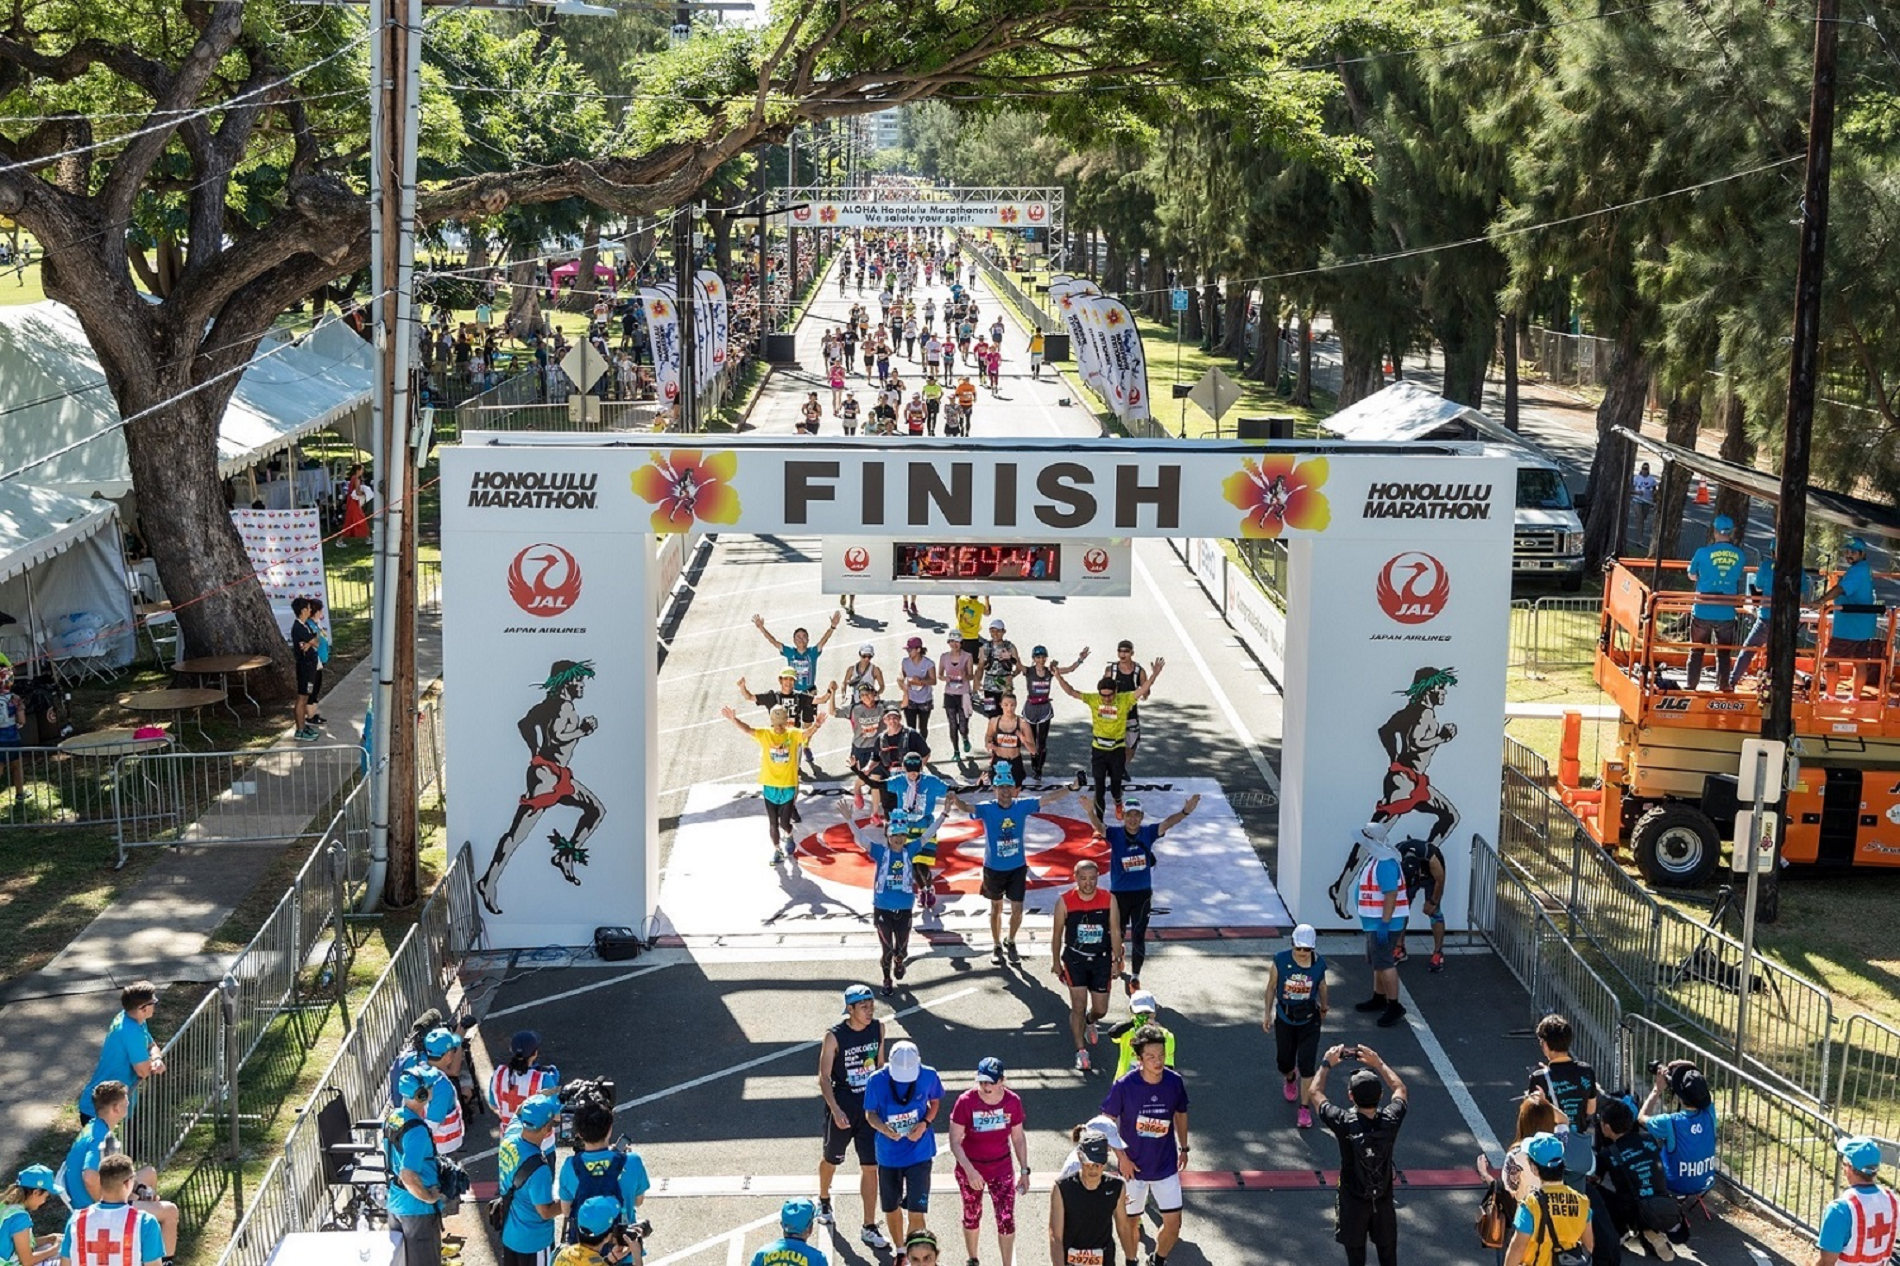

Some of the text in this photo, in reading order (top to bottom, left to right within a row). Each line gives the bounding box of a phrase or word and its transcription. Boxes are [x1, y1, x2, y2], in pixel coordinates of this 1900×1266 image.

[841, 205, 998, 214] ALOHA Honolulu Marathoners!
[865, 214, 975, 224] We salute your spirit.
[471, 471, 599, 490] HONOLULU
[784, 460, 1181, 529] FINISH
[1368, 483, 1492, 500] HONOLULU
[468, 490, 597, 509] MARATHON
[1363, 502, 1490, 520] MARATHON
[528, 595, 568, 609] JAL
[1395, 603, 1434, 616] JAL
[1403, 634, 1452, 642] AIRLINES
[1655, 696, 1692, 711] JLG
[895, 1111, 914, 1121] JAL
[980, 1109, 999, 1117] JAL
[979, 1116, 1003, 1125] 2972
[1678, 1155, 1715, 1178] PHOTO
[1547, 1192, 1579, 1205] FICIAL
[1548, 1203, 1579, 1218] REW
[764, 1250, 809, 1266] KOKUA
[1076, 1248, 1097, 1257] JAL
[1068, 1255, 1101, 1266] 29765
